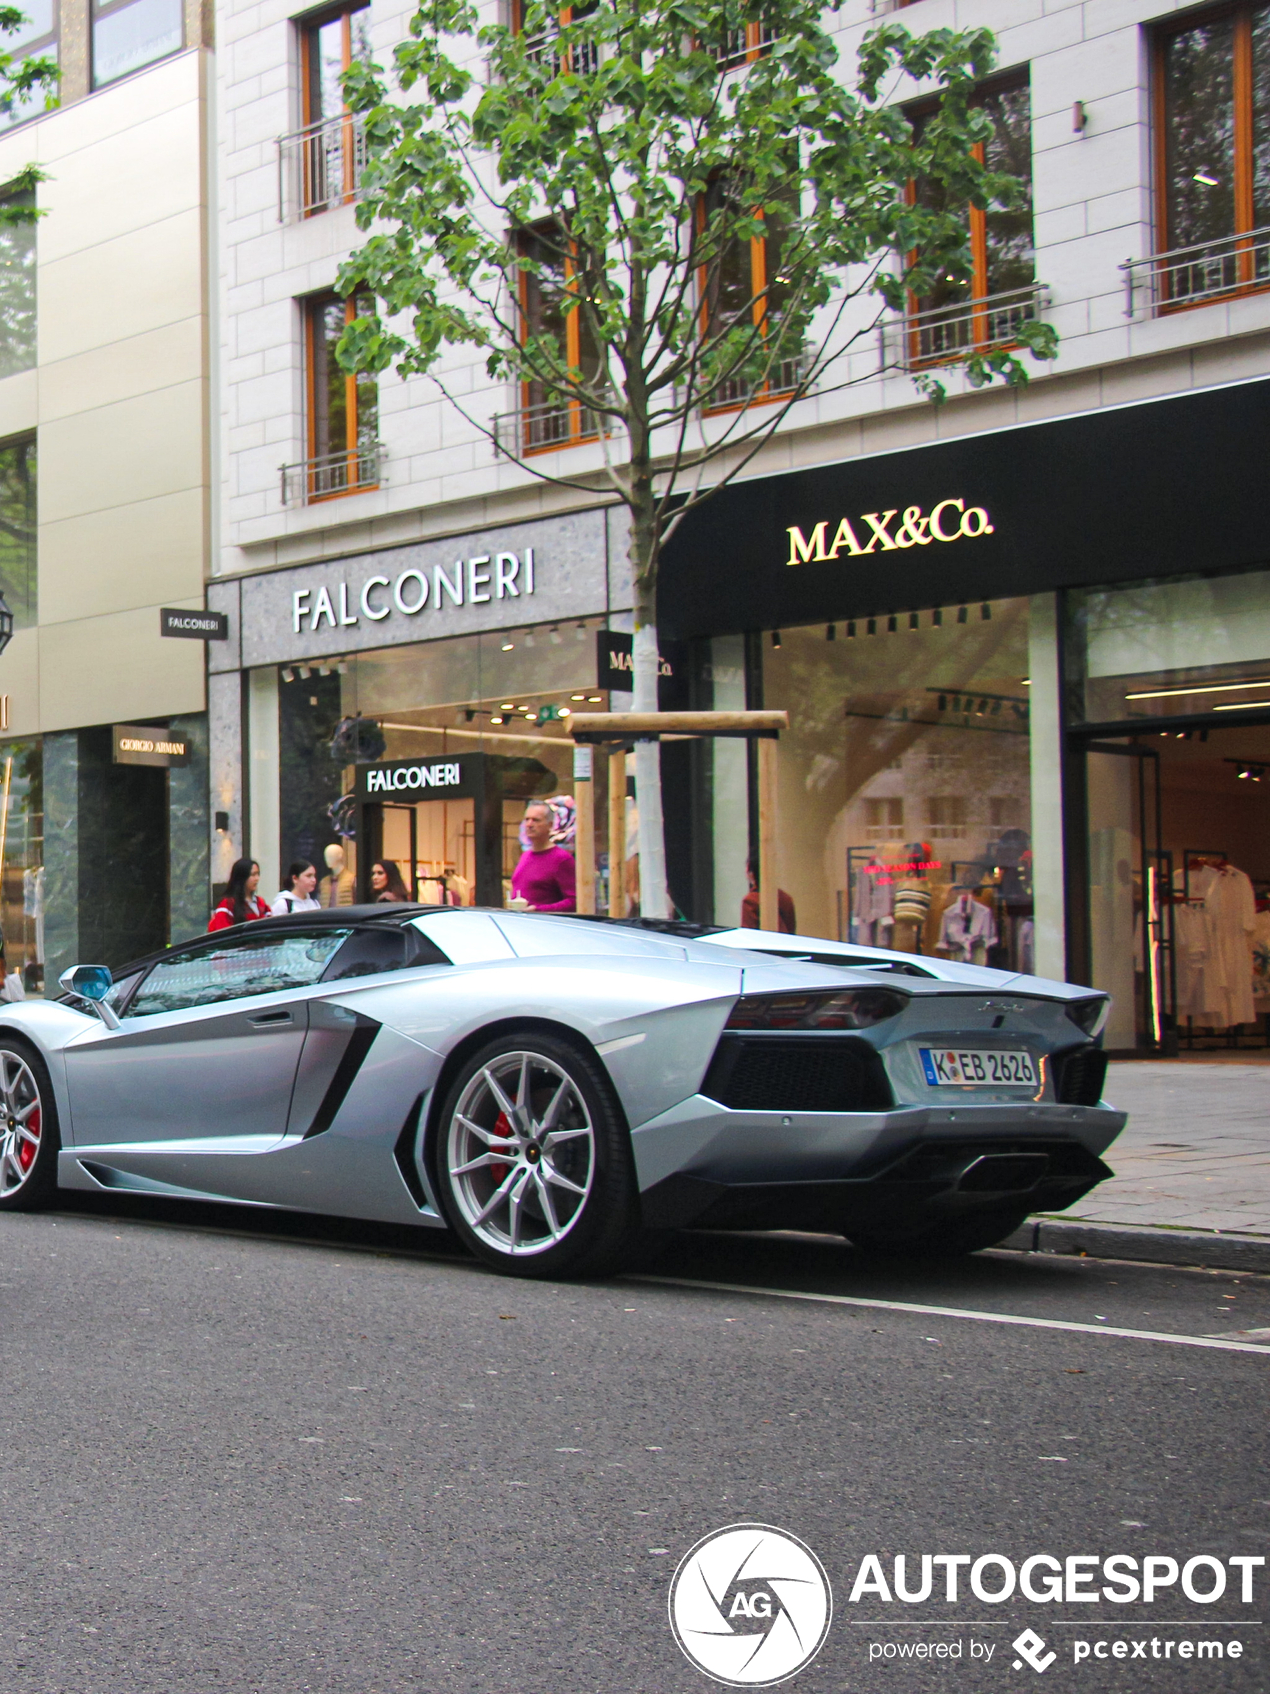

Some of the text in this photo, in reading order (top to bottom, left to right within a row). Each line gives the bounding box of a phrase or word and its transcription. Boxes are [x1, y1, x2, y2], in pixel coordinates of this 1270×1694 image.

[785, 497, 995, 566] MAX&Co.
[293, 547, 535, 633] FALCONERI
[167, 616, 219, 631] FALCONERI
[119, 738, 185, 755] GIORGIO ARMANI
[366, 763, 460, 793] FALCONERI
[933, 1053, 1033, 1082] K EB 2626
